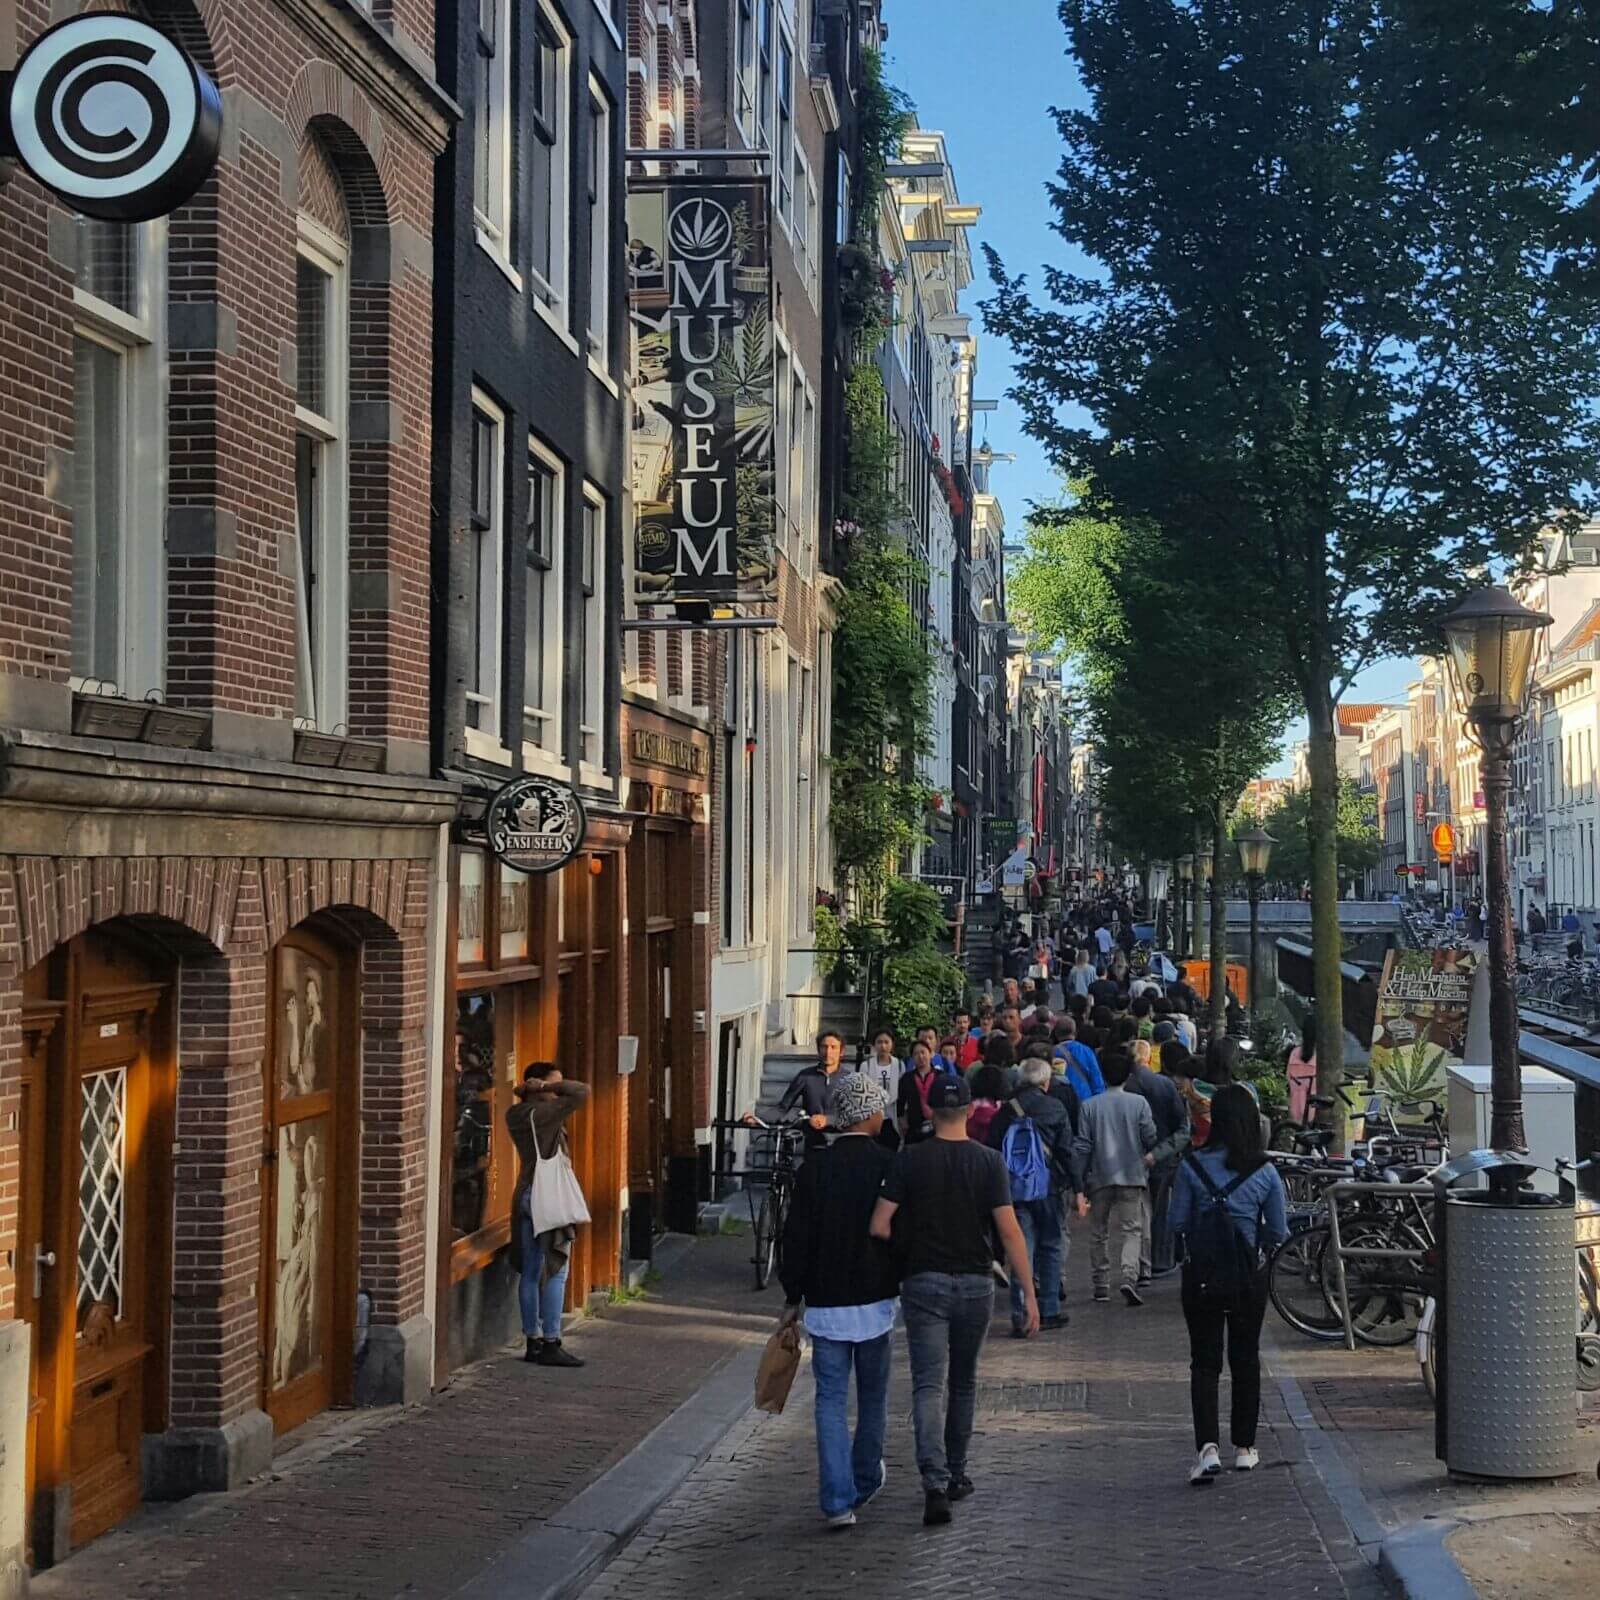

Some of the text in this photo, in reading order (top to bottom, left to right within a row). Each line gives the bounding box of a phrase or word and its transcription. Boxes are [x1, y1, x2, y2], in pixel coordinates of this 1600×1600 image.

[668, 259, 734, 577] MUSEUM
[494, 831, 573, 854] SENSI SEEDS
[1384, 981, 1467, 1000] & Hemp Museum
